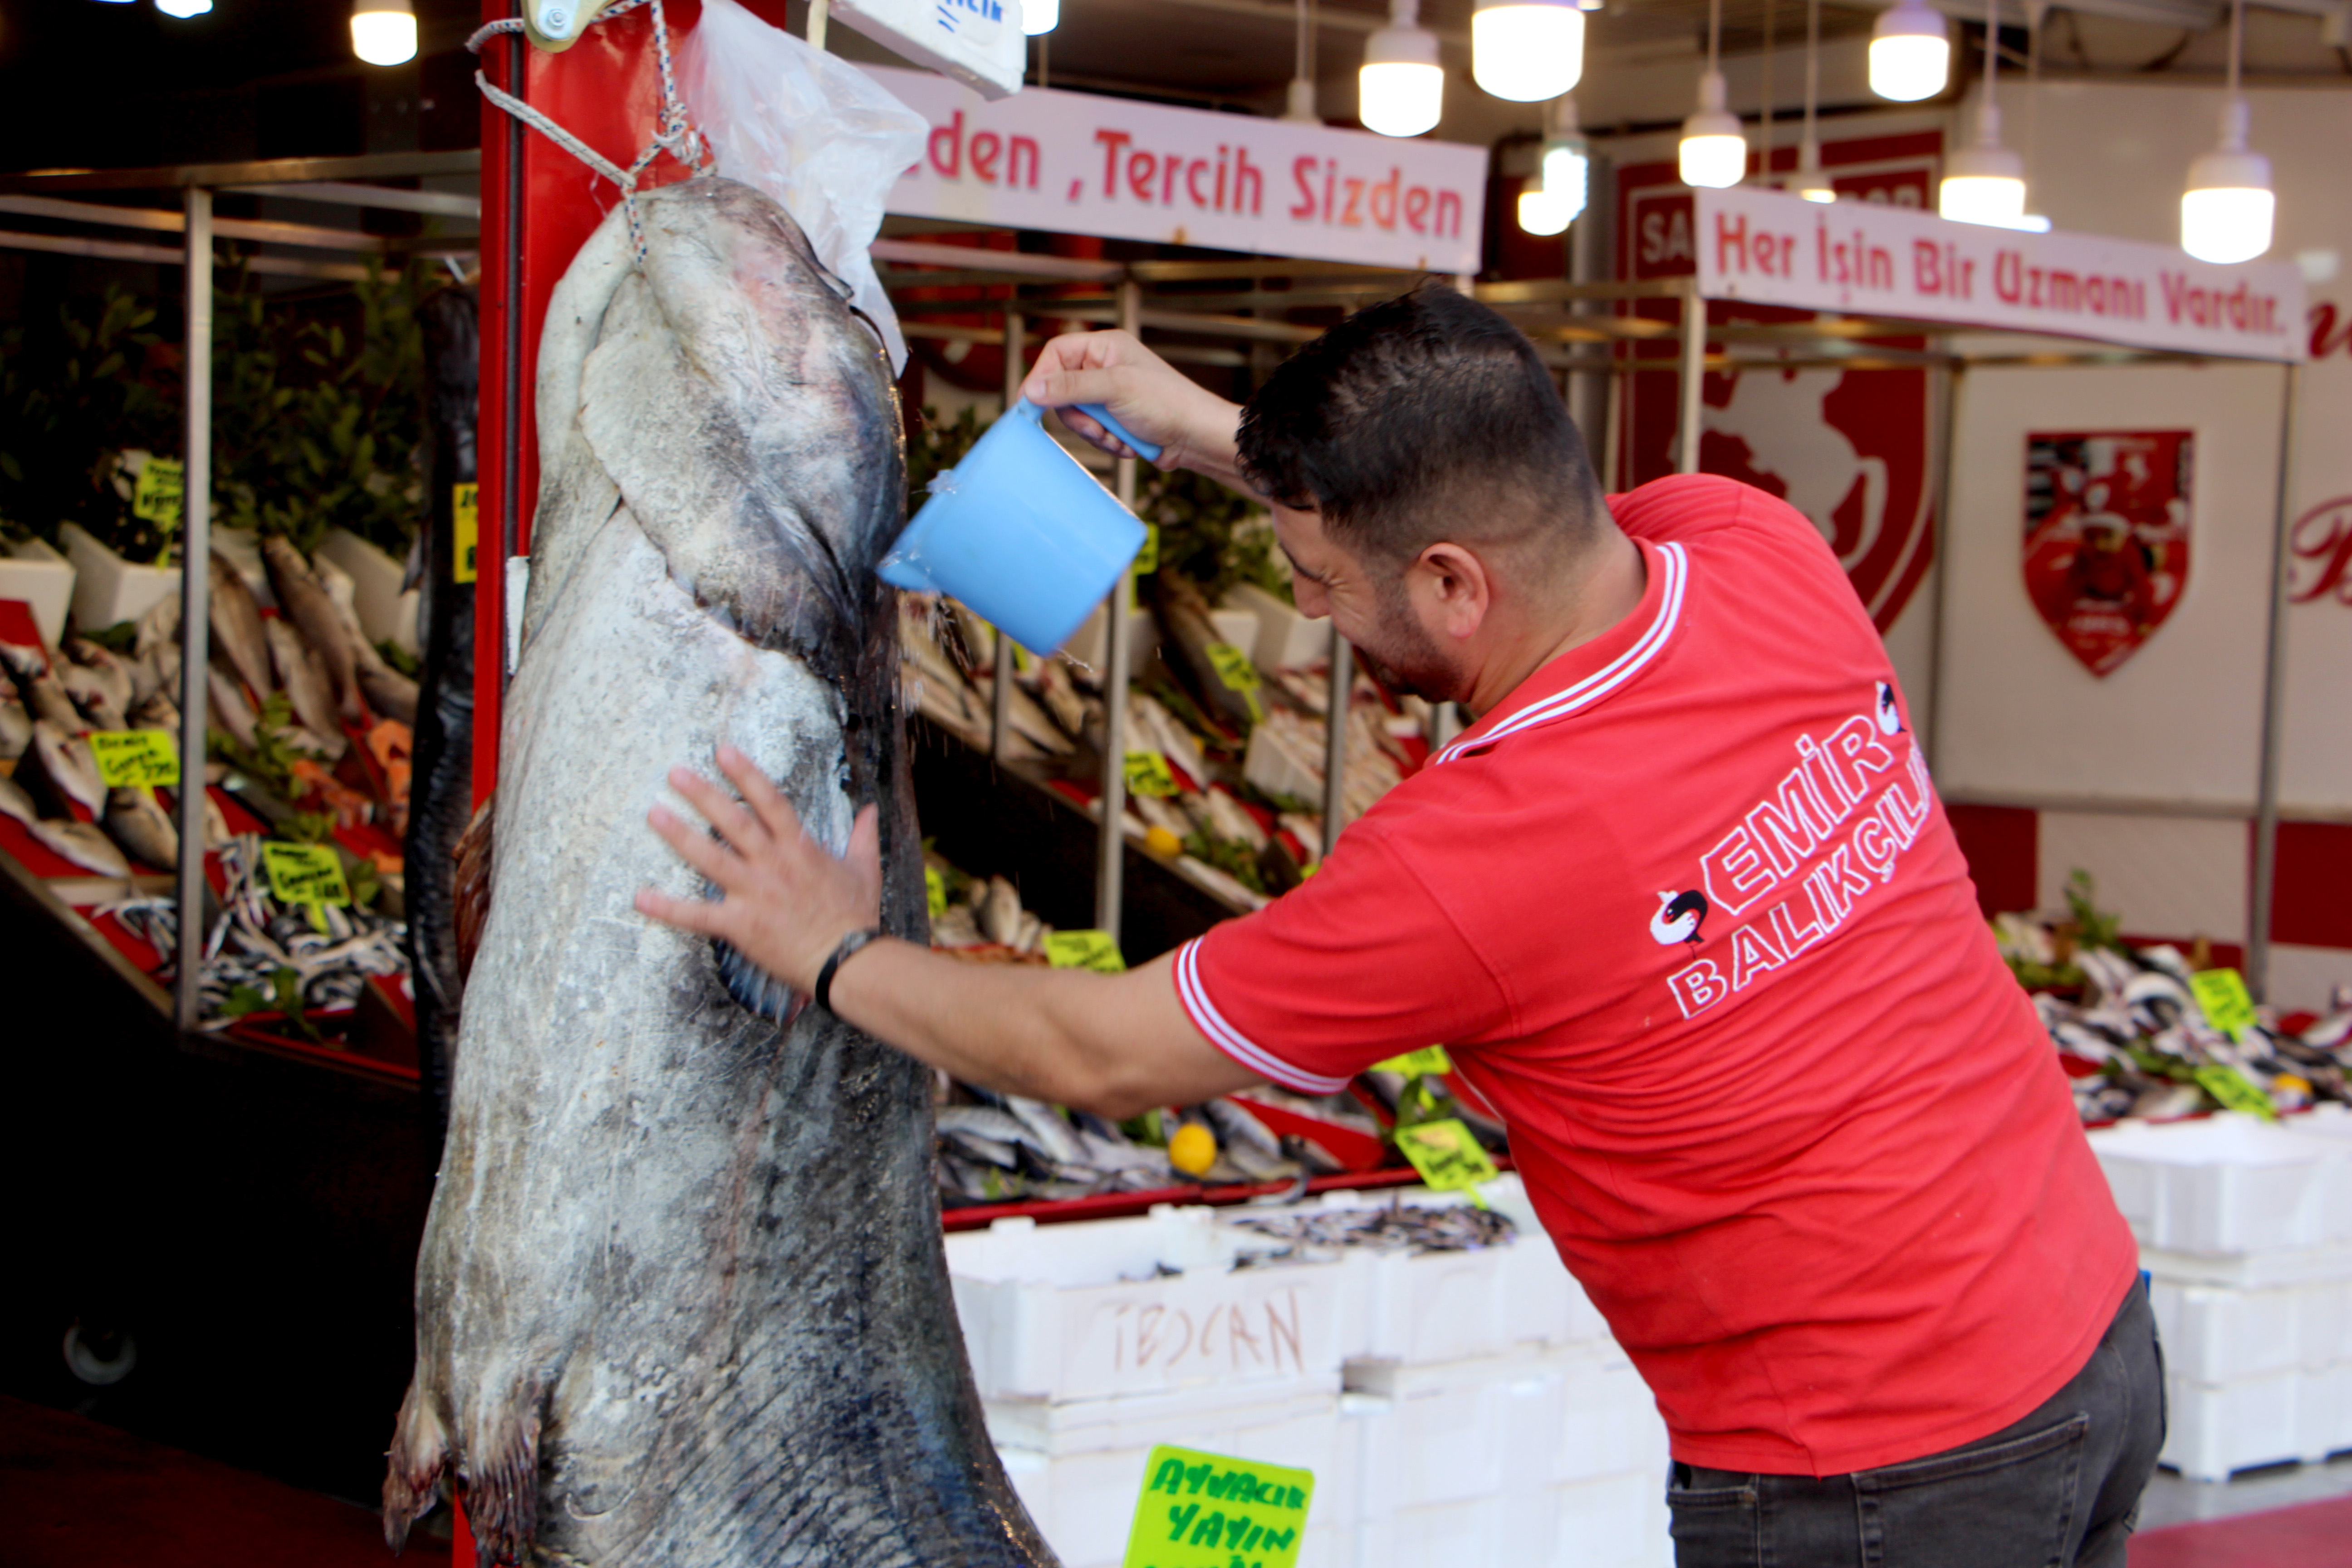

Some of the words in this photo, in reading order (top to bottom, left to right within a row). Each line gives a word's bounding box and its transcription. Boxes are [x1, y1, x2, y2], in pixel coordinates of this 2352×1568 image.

[904, 111, 1040, 188] den
[1289, 155, 1462, 238] Sizden
[1715, 211, 1795, 277] Her
[1816, 211, 1893, 304] İşin
[1913, 238, 1974, 300] Bir
[1700, 714, 1894, 916] EMİR
[1149, 1458, 1306, 1510] AYVACIK
[1168, 1503, 1296, 1552] YAYIN
